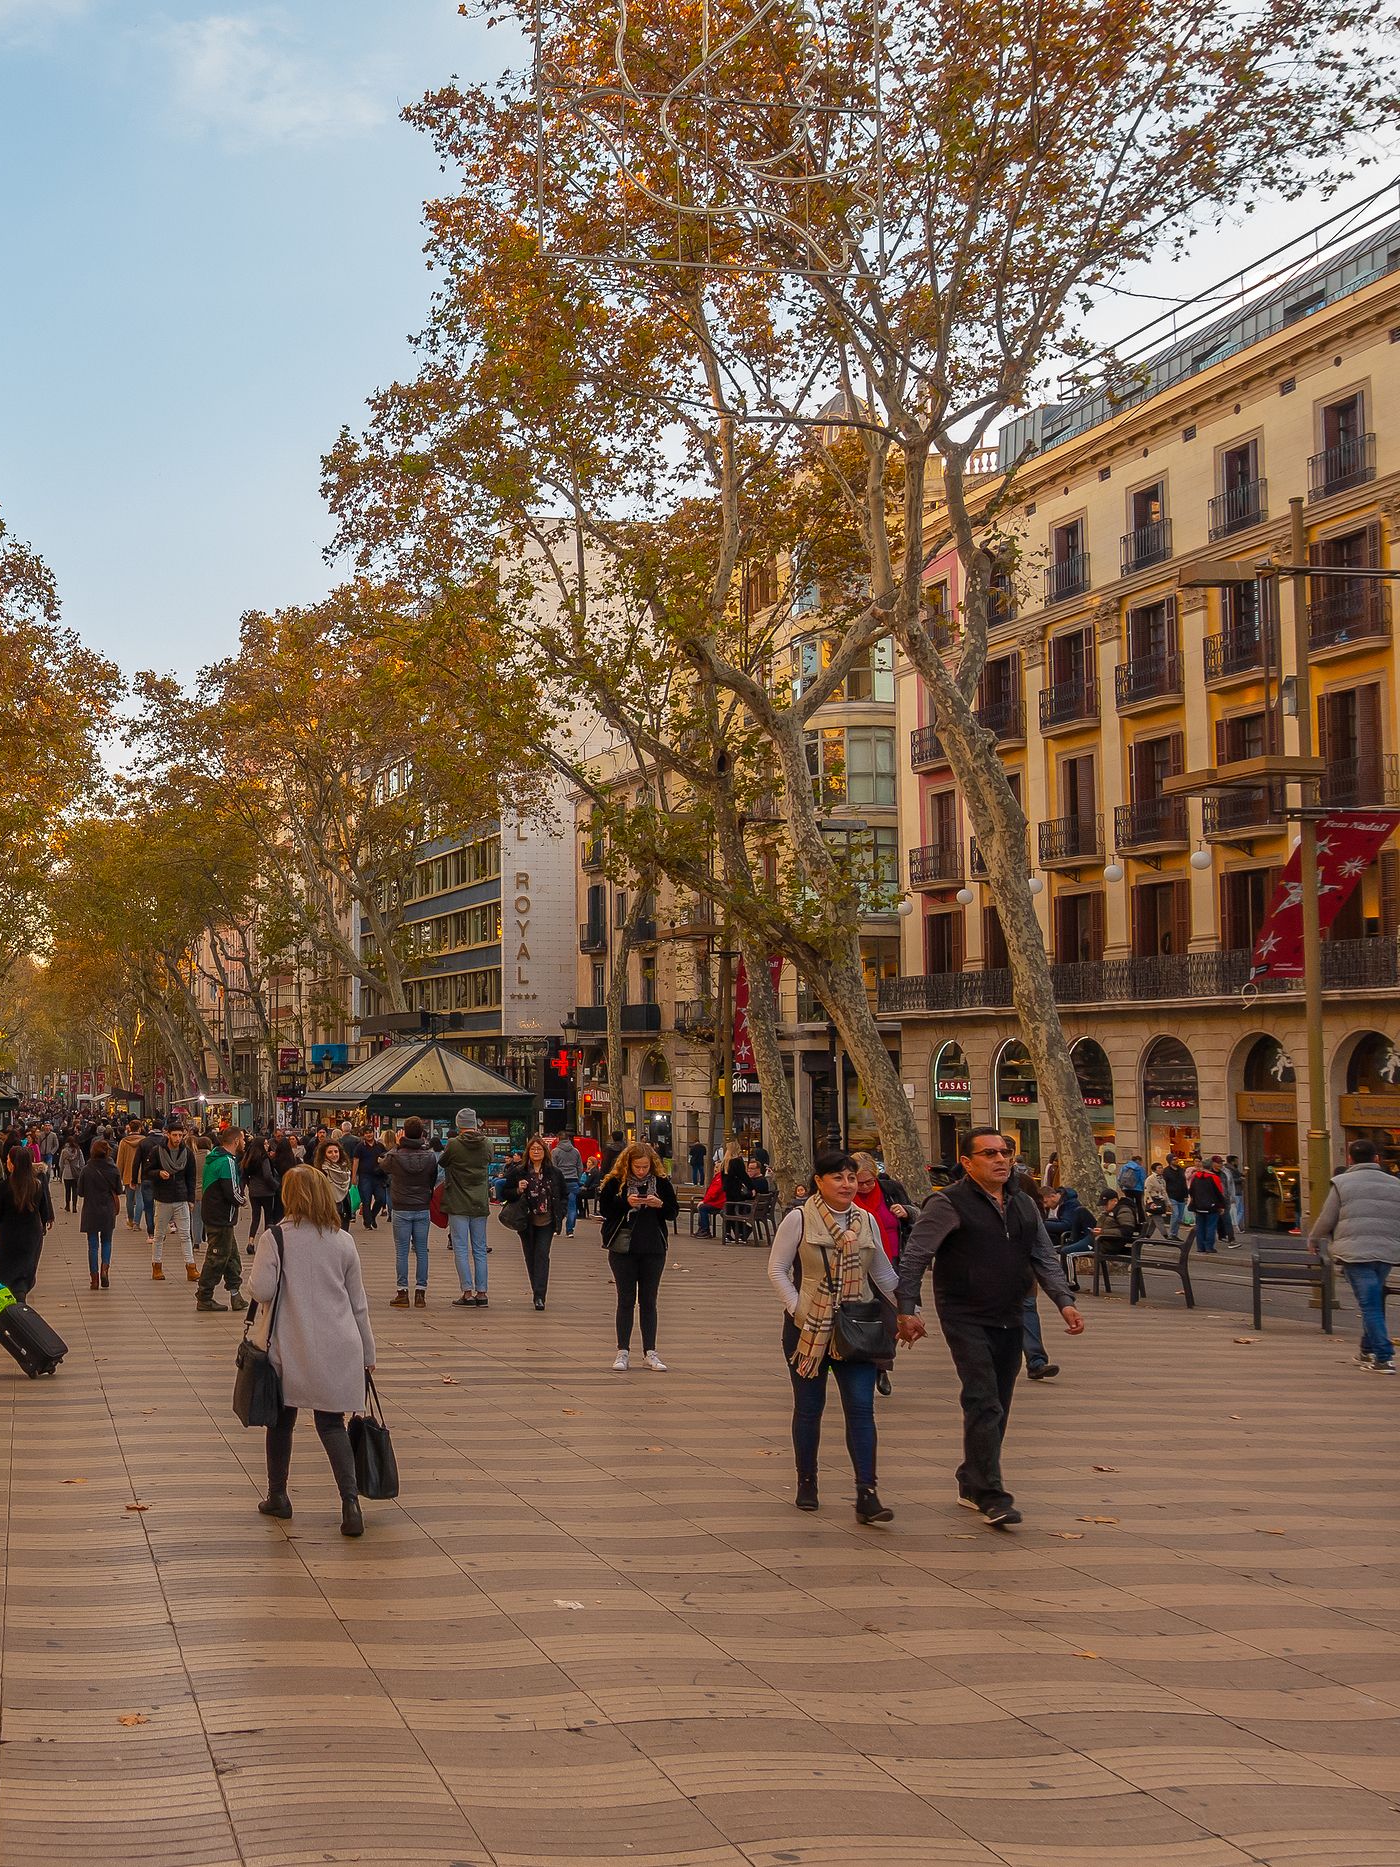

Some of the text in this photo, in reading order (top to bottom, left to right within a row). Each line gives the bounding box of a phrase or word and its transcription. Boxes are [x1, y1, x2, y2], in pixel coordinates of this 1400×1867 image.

[1323, 820, 1349, 829] Fem
[515, 872, 531, 985] ROYAL
[938, 1081, 968, 1090] CASAS
[1160, 1100, 1186, 1108] CASAS
